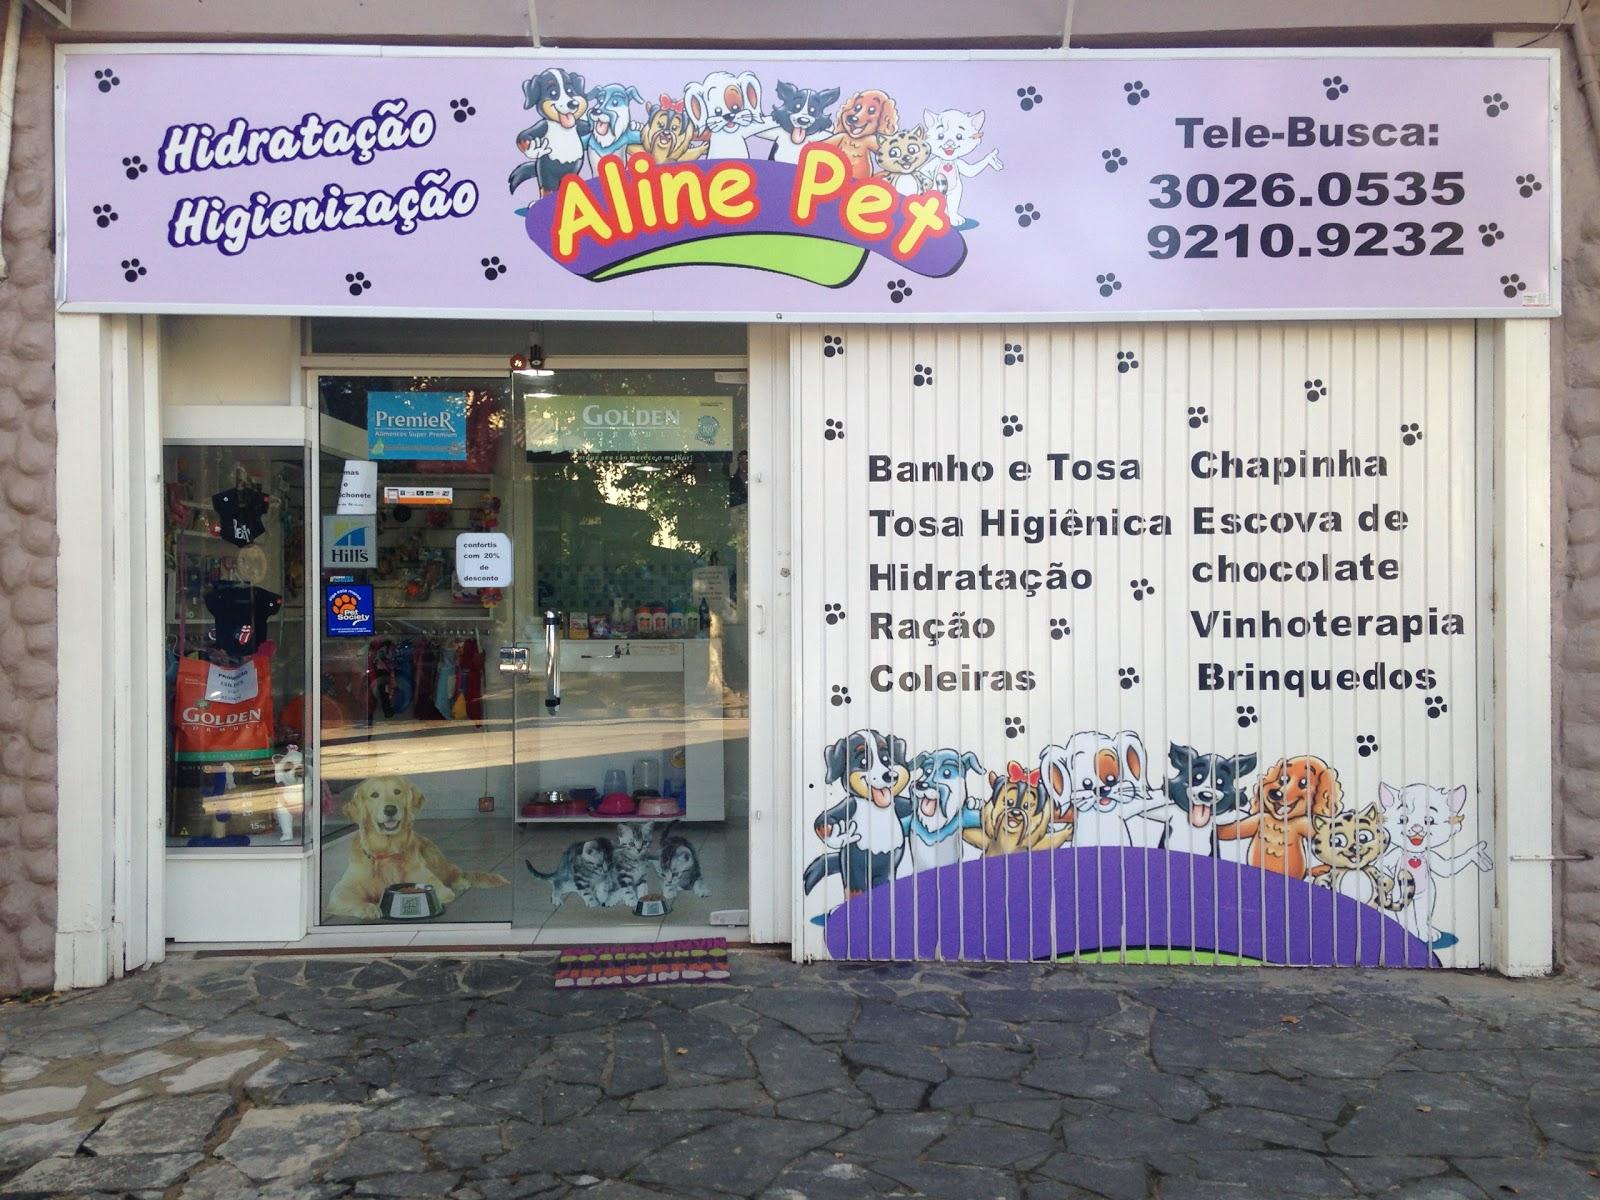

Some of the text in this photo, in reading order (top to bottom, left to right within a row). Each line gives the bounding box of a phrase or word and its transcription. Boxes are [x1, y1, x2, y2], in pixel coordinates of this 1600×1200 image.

[158, 97, 437, 176] Hidratação
[1175, 116, 1439, 148] Tele-Busca:
[552, 143, 951, 264] Aline Pet
[1148, 171, 1466, 209] 3026.0535
[169, 169, 480, 257] Higienização
[1147, 221, 1464, 259] 9210.9232
[582, 404, 681, 426] GOLDEN
[868, 453, 1141, 482] Banho e Tosa
[1190, 449, 1388, 485] Chapinha
[869, 508, 1172, 544] Tosa Higiênica
[1193, 503, 1409, 535] Escova de
[331, 549, 369, 563] Hill's
[1192, 552, 1399, 583] chocolate
[869, 562, 1092, 598] Hidratação
[337, 614, 370, 624] Society
[870, 611, 995, 647] Ração
[1190, 607, 1465, 643] Vinhoterapia
[870, 664, 1036, 692] Coleiras
[1198, 661, 1438, 698] Brinquedos
[182, 707, 262, 726] GOLDEN
